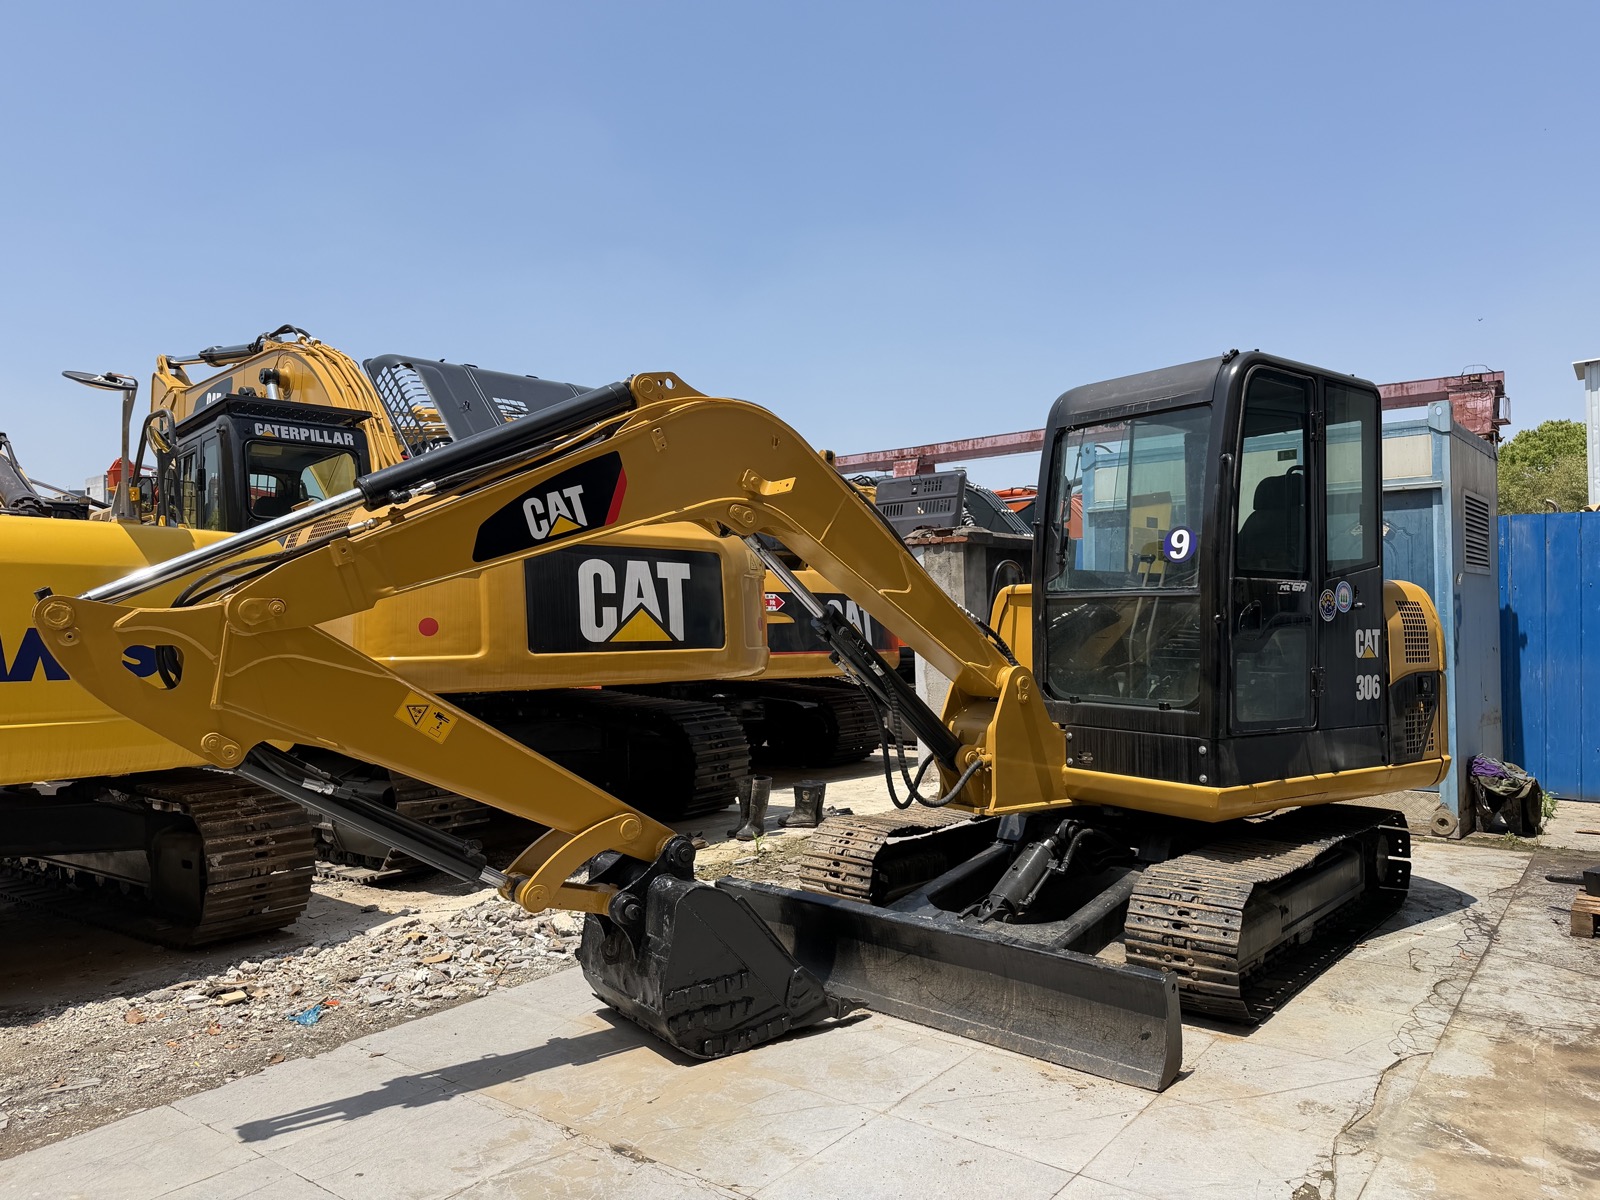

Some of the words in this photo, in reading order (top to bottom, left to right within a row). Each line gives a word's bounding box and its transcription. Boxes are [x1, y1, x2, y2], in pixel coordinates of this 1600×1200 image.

[254, 422, 354, 446] CATERPILLAR
[522, 484, 588, 540] CAT
[1169, 529, 1190, 560] 9
[578, 558, 691, 643] CAT
[1355, 629, 1381, 659] CAT
[1356, 674, 1380, 700] 306
